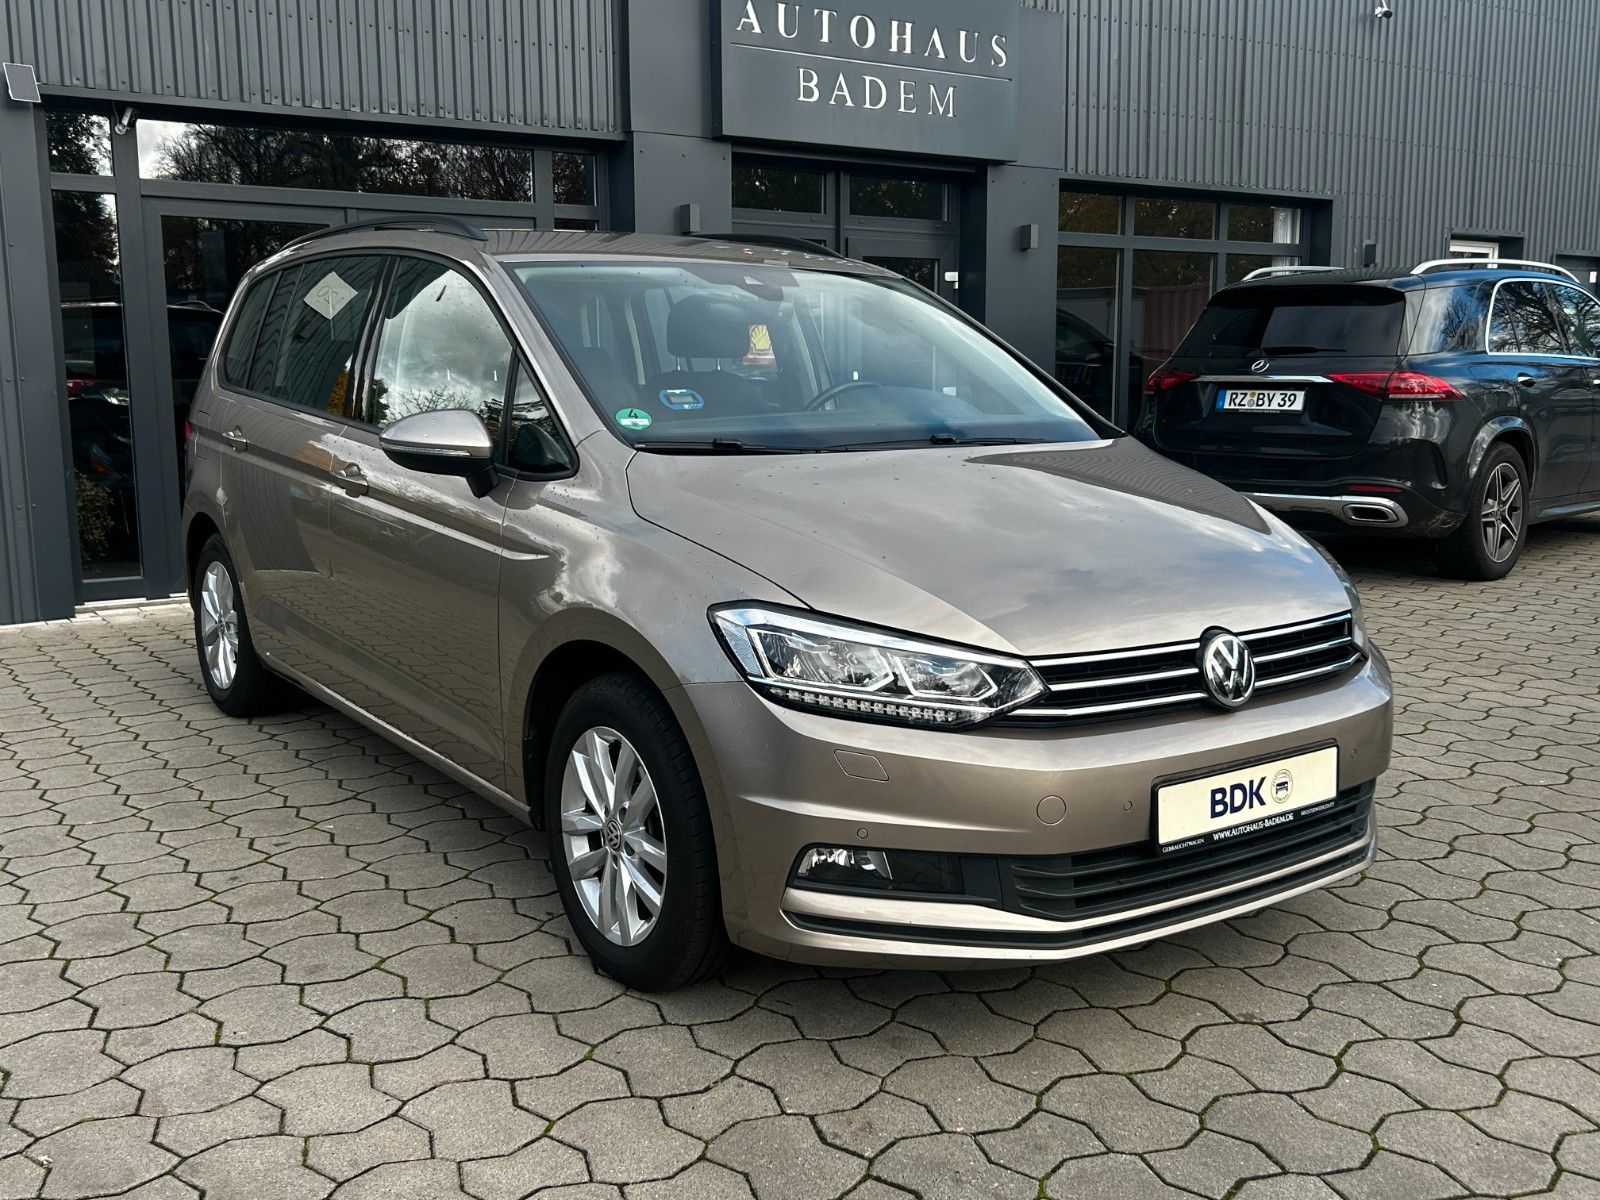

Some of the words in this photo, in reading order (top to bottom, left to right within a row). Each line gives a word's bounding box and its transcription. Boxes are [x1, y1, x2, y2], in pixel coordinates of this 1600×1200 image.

[736, 0, 1008, 67] AUTOHAUS
[797, 67, 957, 117] BADEM
[628, 409, 638, 419] 4
[1228, 392, 1248, 407] RZ
[1256, 392, 1276, 407] BY
[1277, 392, 1297, 408] 39
[1210, 776, 1267, 819] BDK
